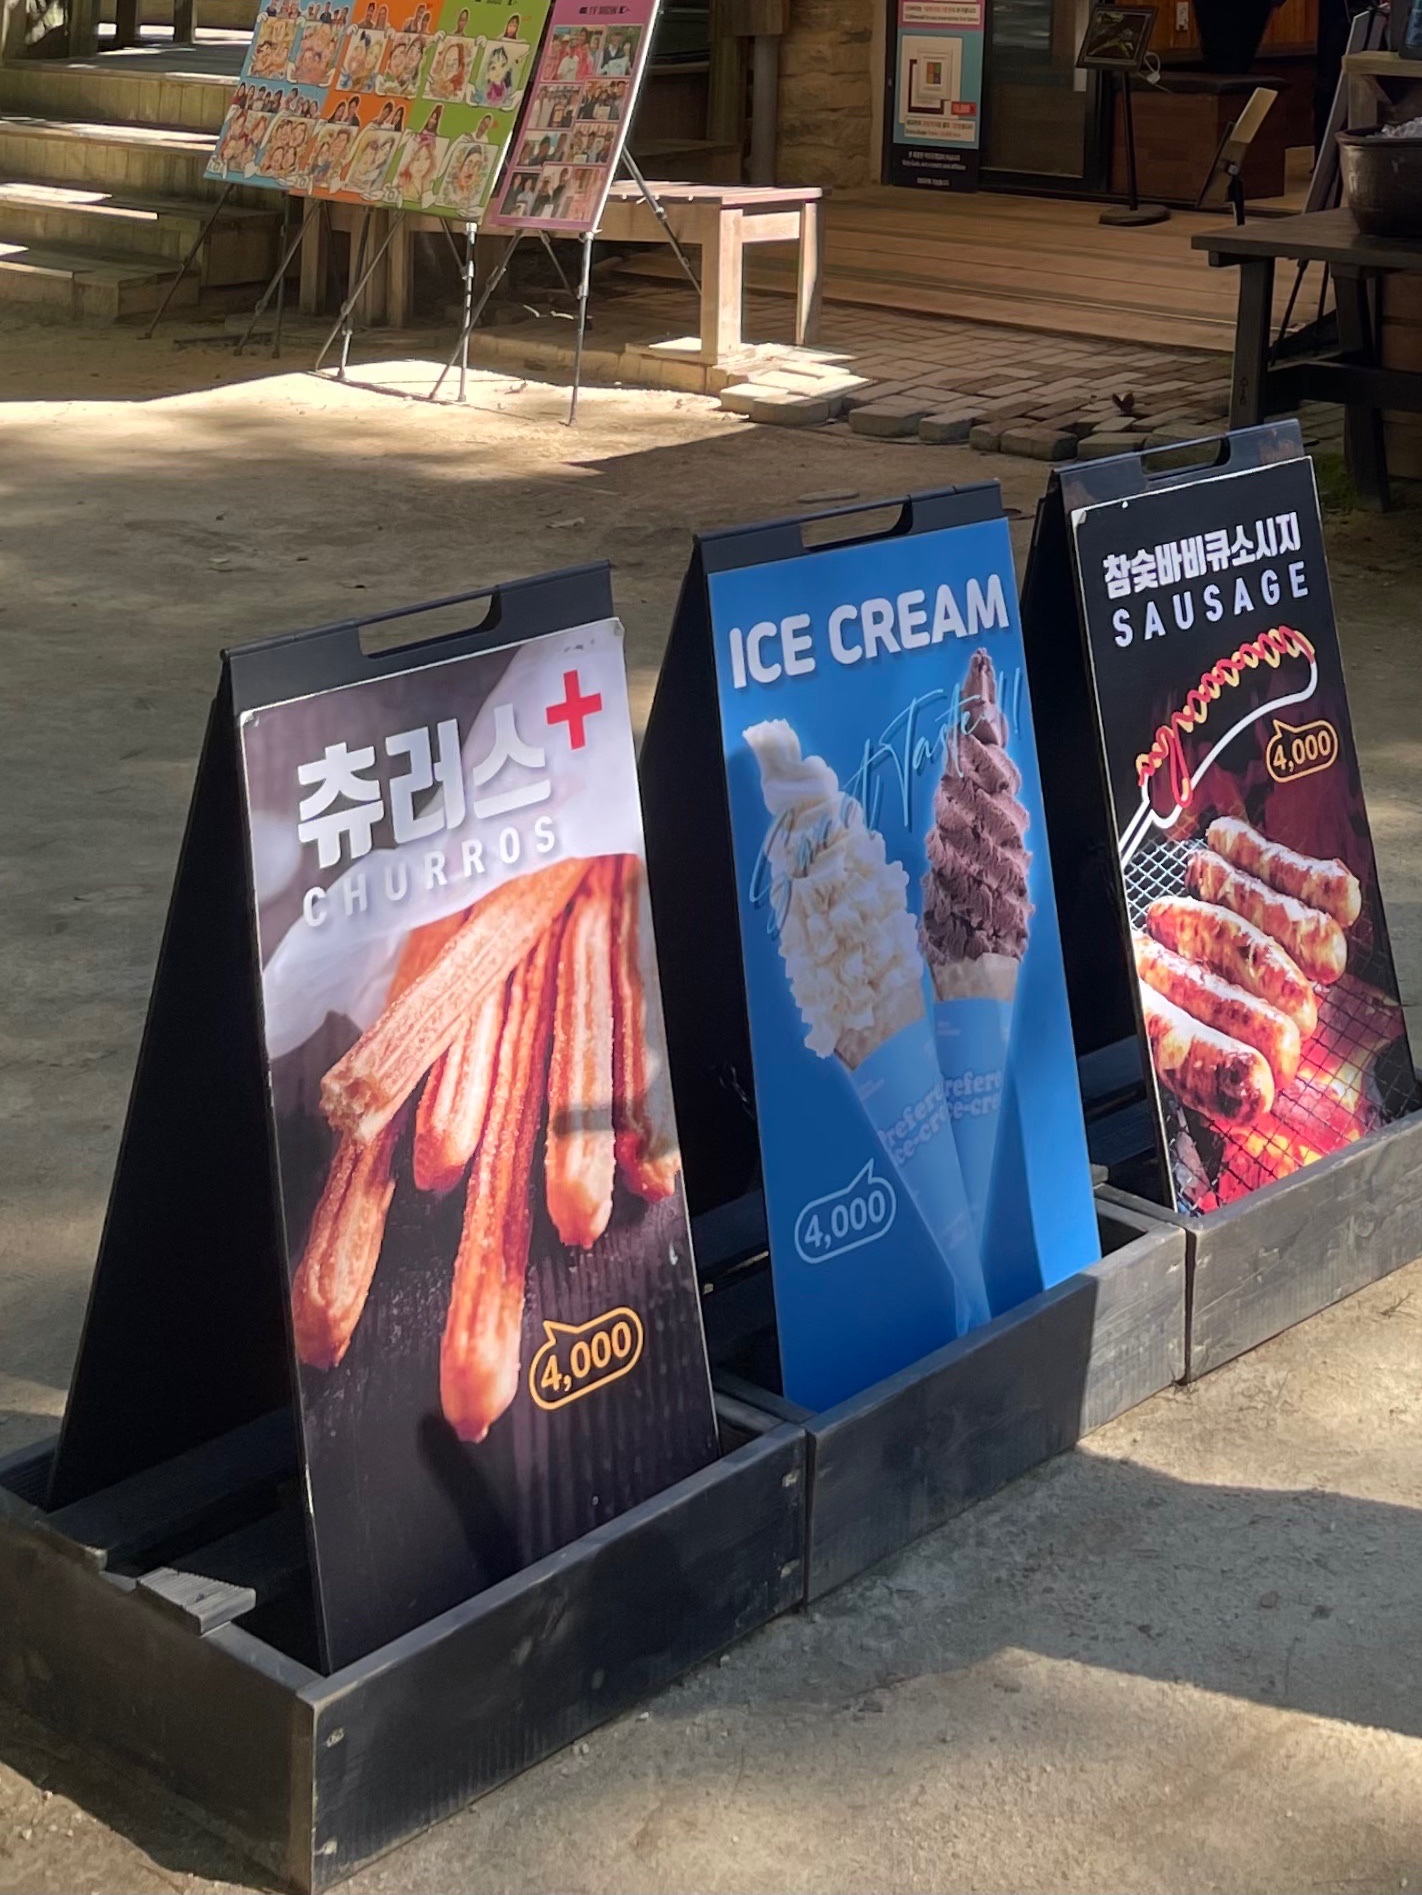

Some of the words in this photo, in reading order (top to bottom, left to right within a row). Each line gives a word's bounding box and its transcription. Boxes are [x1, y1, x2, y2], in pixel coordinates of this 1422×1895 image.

[1102, 511, 1302, 600] 참숯바비큐소시지
[728, 613, 817, 689] ICE
[828, 573, 1010, 666] CREAM
[1111, 560, 1309, 648] SAUSAGE
[1273, 729, 1331, 773] 4,000
[303, 815, 556, 928] CHURROS
[803, 1189, 886, 1250] 4,000
[540, 1320, 633, 1392] 4,000
